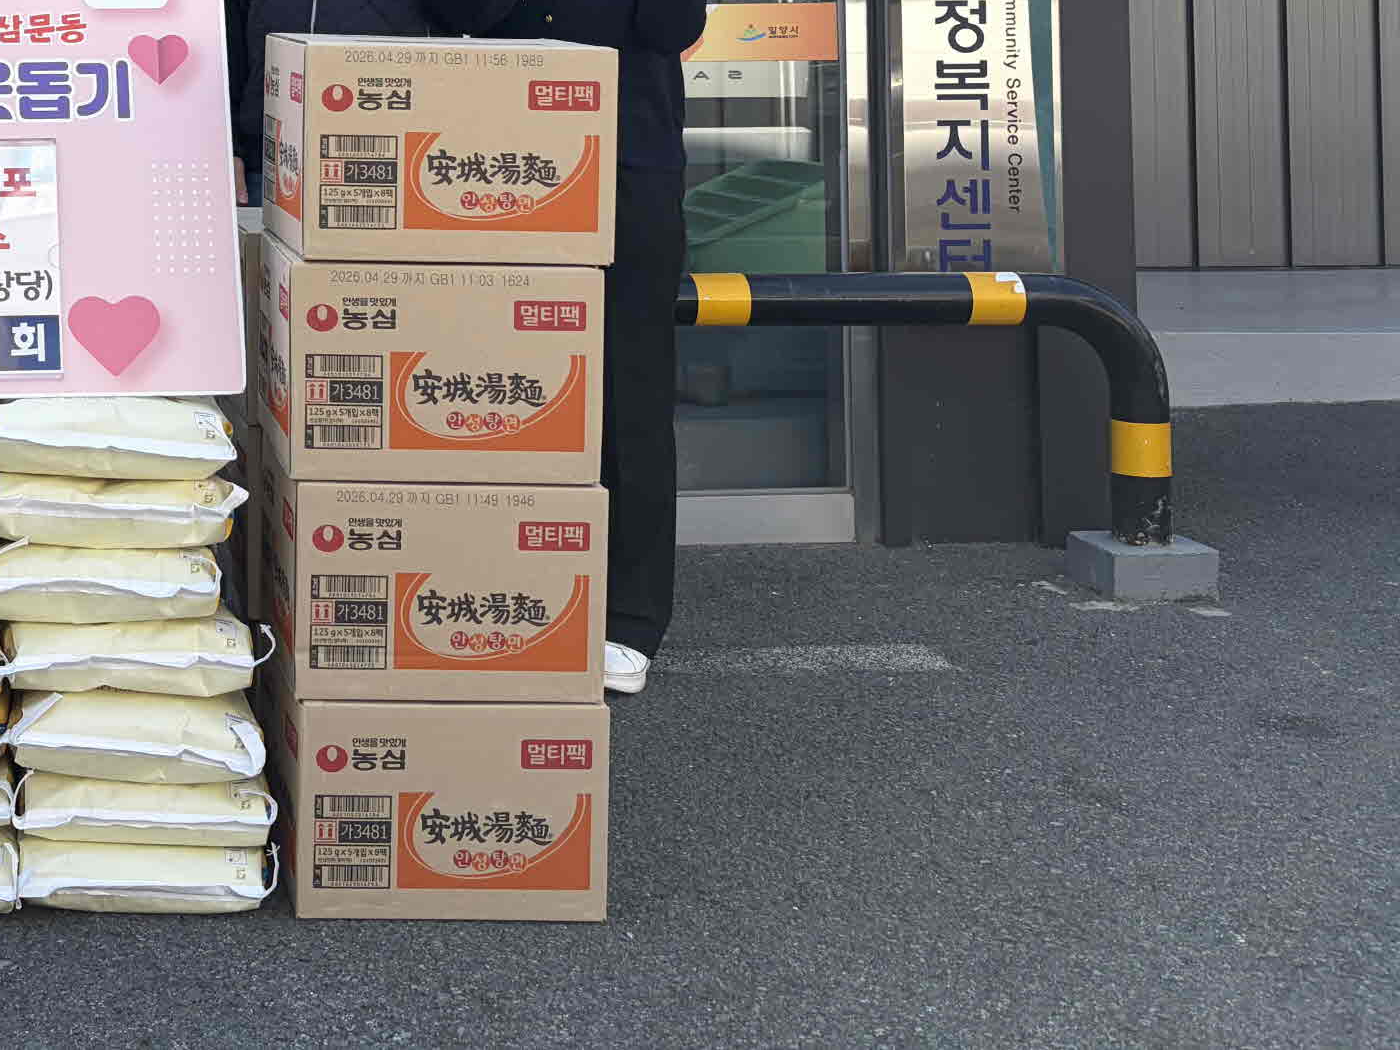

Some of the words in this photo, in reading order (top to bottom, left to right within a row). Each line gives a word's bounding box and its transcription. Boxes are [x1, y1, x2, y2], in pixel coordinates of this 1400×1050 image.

[358, 78, 383, 87] 인생을
[385, 78, 412, 88] 맛있게
[356, 88, 411, 112] 농심
[533, 84, 594, 107] 멀티팩
[1005, 78, 1021, 146] Service
[346, 165, 393, 181] 가3481
[425, 152, 560, 188] 安城湯麵
[1007, 153, 1023, 212] Center
[459, 193, 533, 214] 안성탕면
[343, 297, 368, 306] 인생을
[370, 297, 397, 307] 맛있게
[341, 308, 396, 331] 농심
[520, 304, 581, 327] 멀티팩
[331, 384, 379, 401] 가3481
[411, 372, 547, 408] 安城湯麵
[446, 413, 520, 434] 안성탕면
[349, 519, 374, 528] 인생을
[376, 519, 402, 529] 맛있게
[347, 529, 402, 552] 농심
[524, 524, 584, 548] 멀티팩
[337, 605, 384, 621] 가3481
[416, 592, 550, 627] 安城湯麵
[449, 632, 523, 654] 안성탕면
[353, 739, 378, 748] 인생을
[380, 739, 406, 749] 맛있게
[351, 749, 405, 772] 농심
[526, 745, 586, 767] 멀티팩
[340, 824, 387, 840] 가3481
[419, 811, 553, 846] 安城湯麵
[453, 851, 526, 873] 안성탕면
